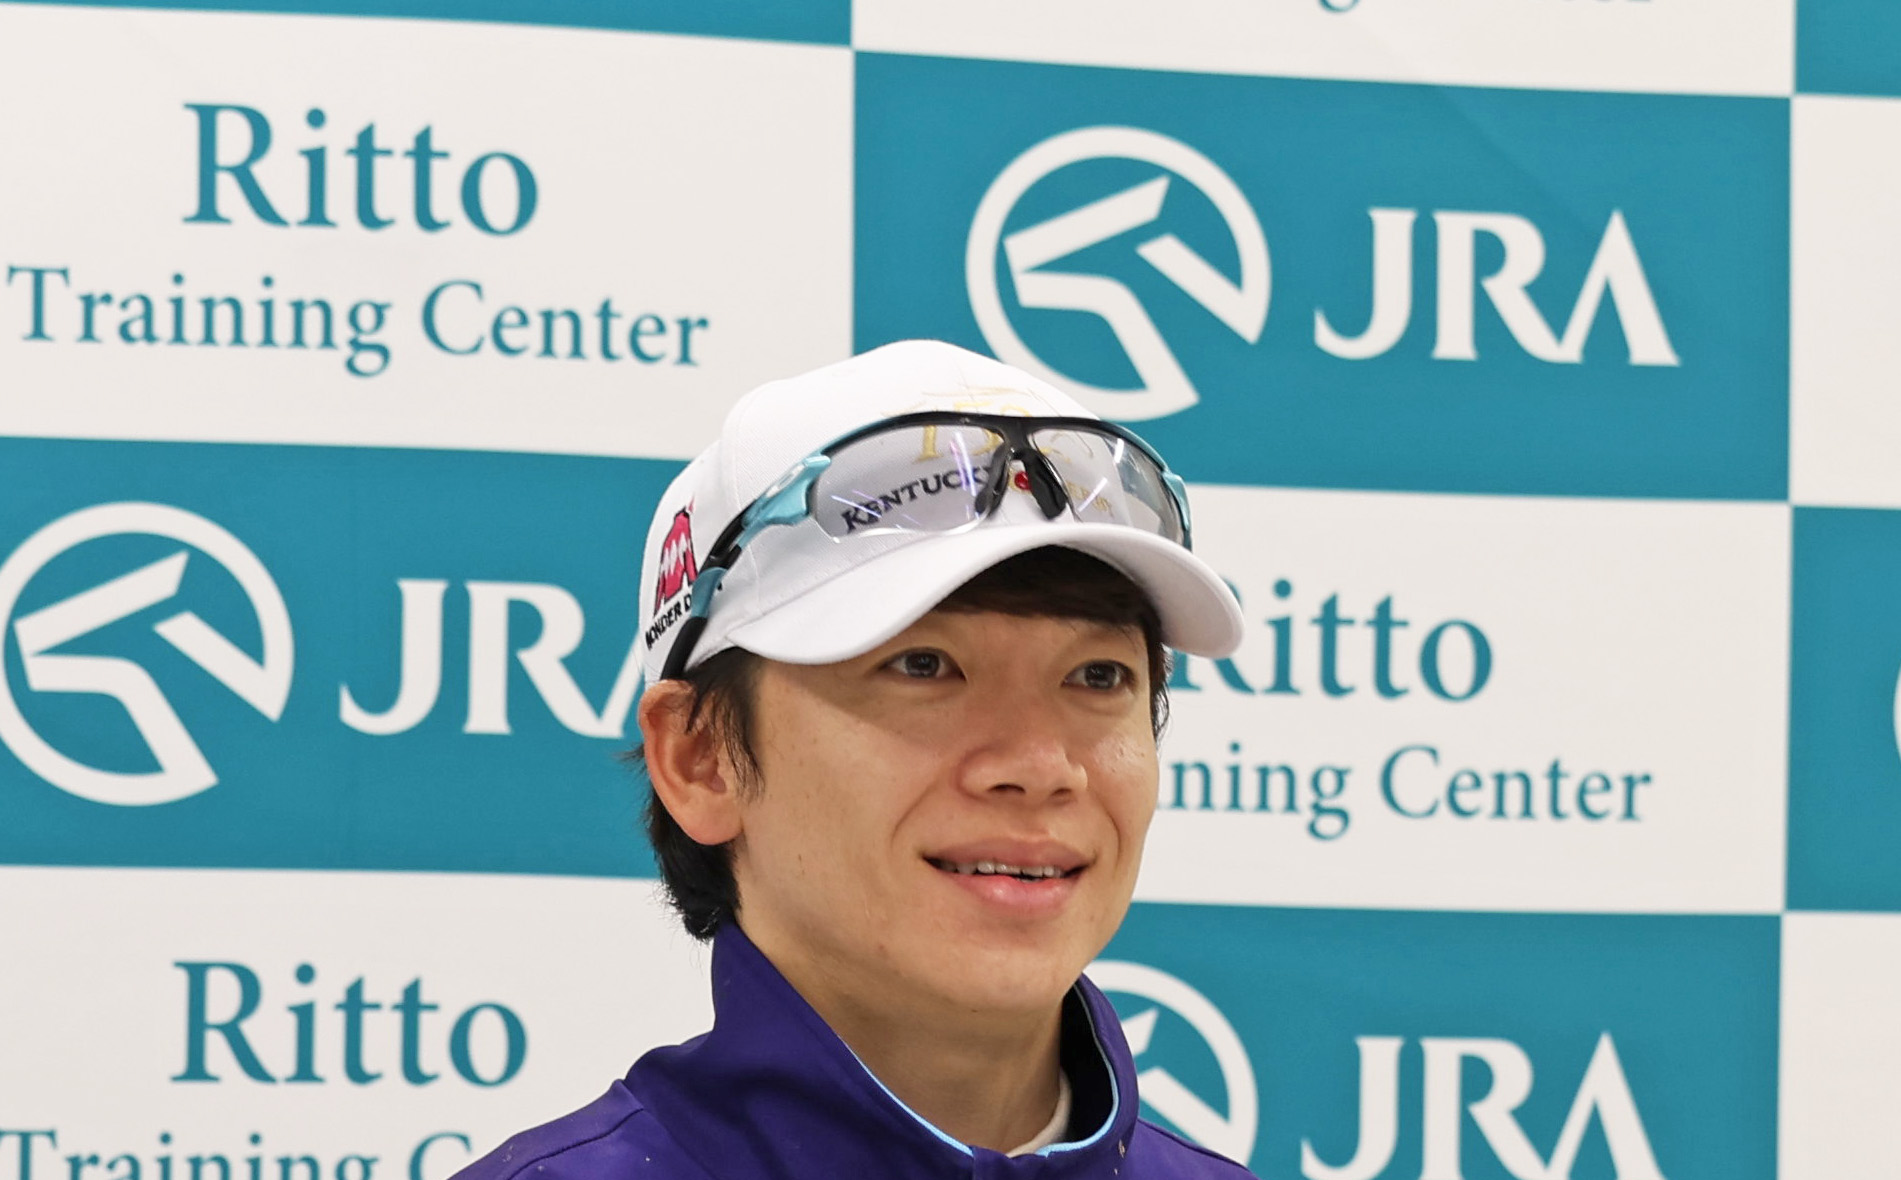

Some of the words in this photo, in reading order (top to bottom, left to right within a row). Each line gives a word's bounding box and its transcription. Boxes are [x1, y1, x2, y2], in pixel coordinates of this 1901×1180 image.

[182, 102, 540, 237] Ritto
[7, 265, 393, 378] Training
[421, 280, 710, 366] Center
[1314, 208, 1680, 366] JRA
[339, 579, 642, 738] JR
[1170, 741, 1352, 841] ning
[1379, 745, 1653, 821] Center
[172, 960, 528, 1089] Ritto
